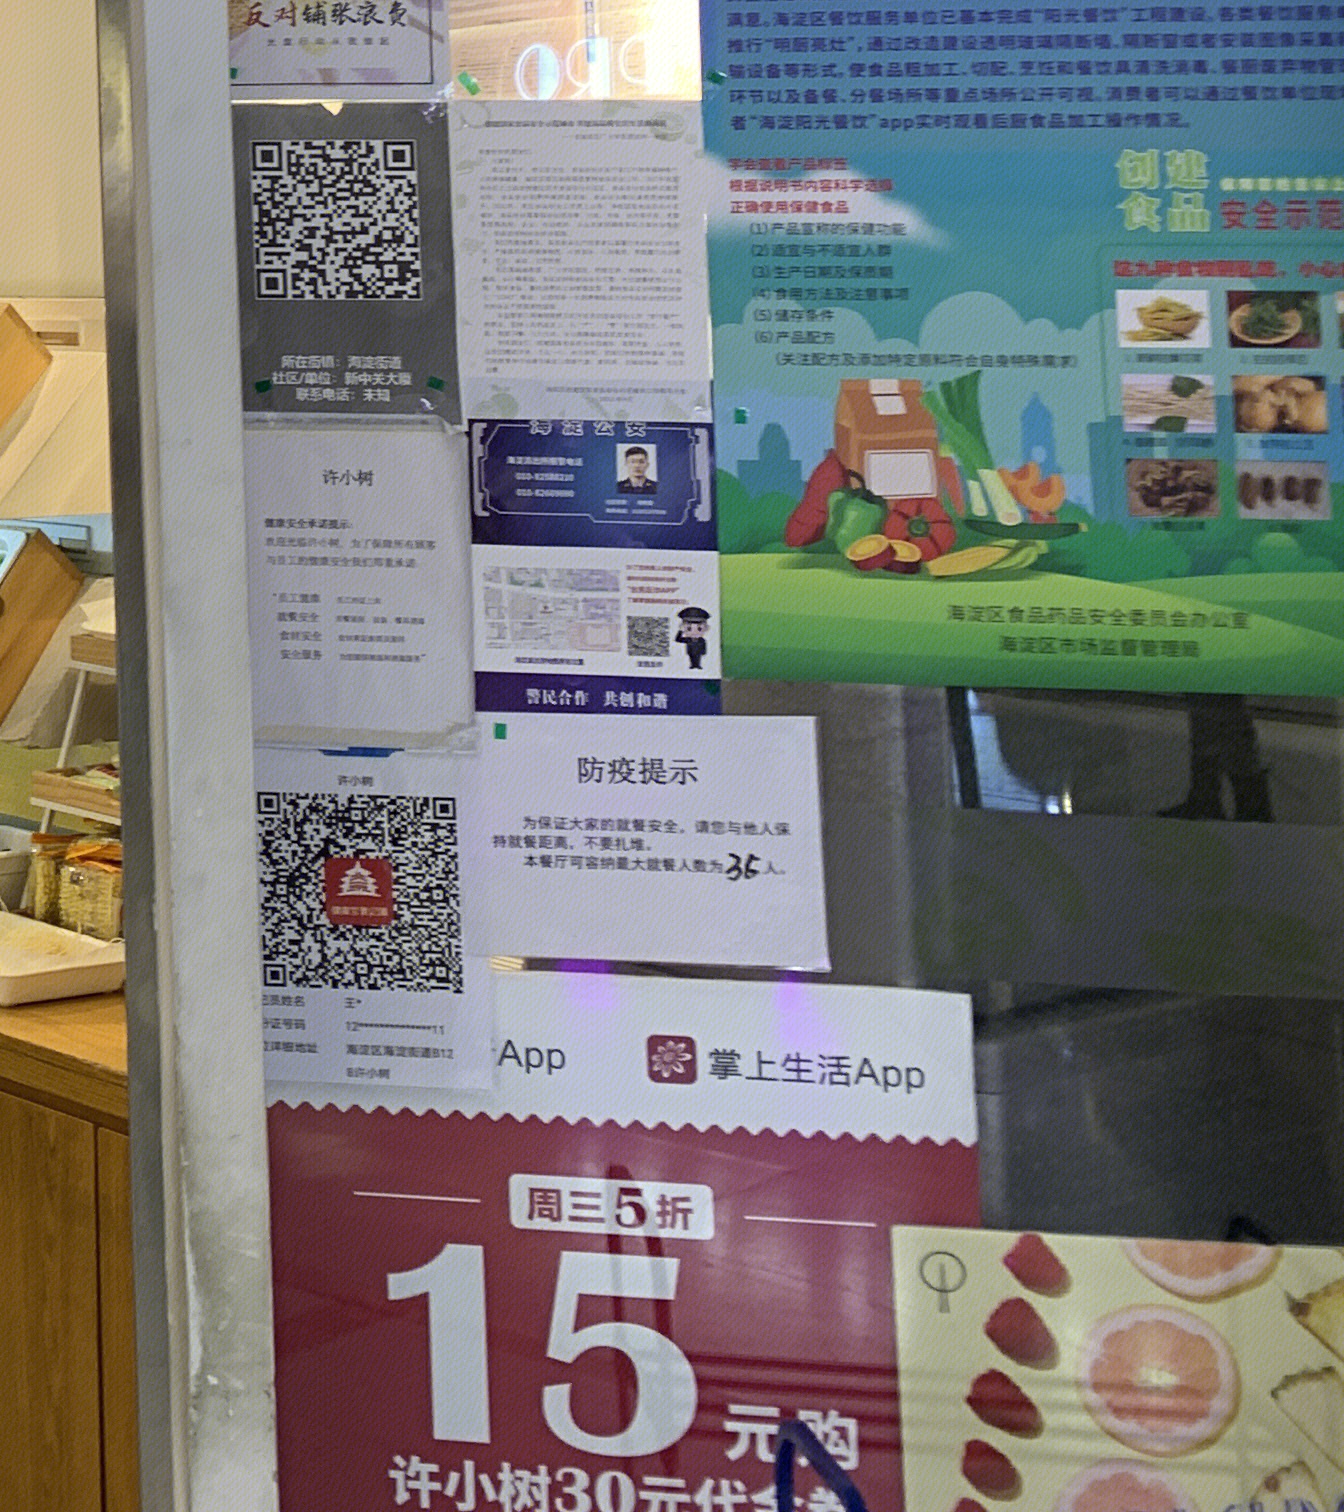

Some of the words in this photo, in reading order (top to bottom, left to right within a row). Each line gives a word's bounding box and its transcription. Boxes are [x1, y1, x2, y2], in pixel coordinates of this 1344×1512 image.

[322, 468, 375, 488] 许小树
[338, 775, 374, 787] 许小树
[577, 755, 698, 786] 防疫提示
[707, 1045, 927, 1095] 掌上生活App
[526, 1185, 695, 1231] 周三5折
[385, 1241, 699, 1460] 15
